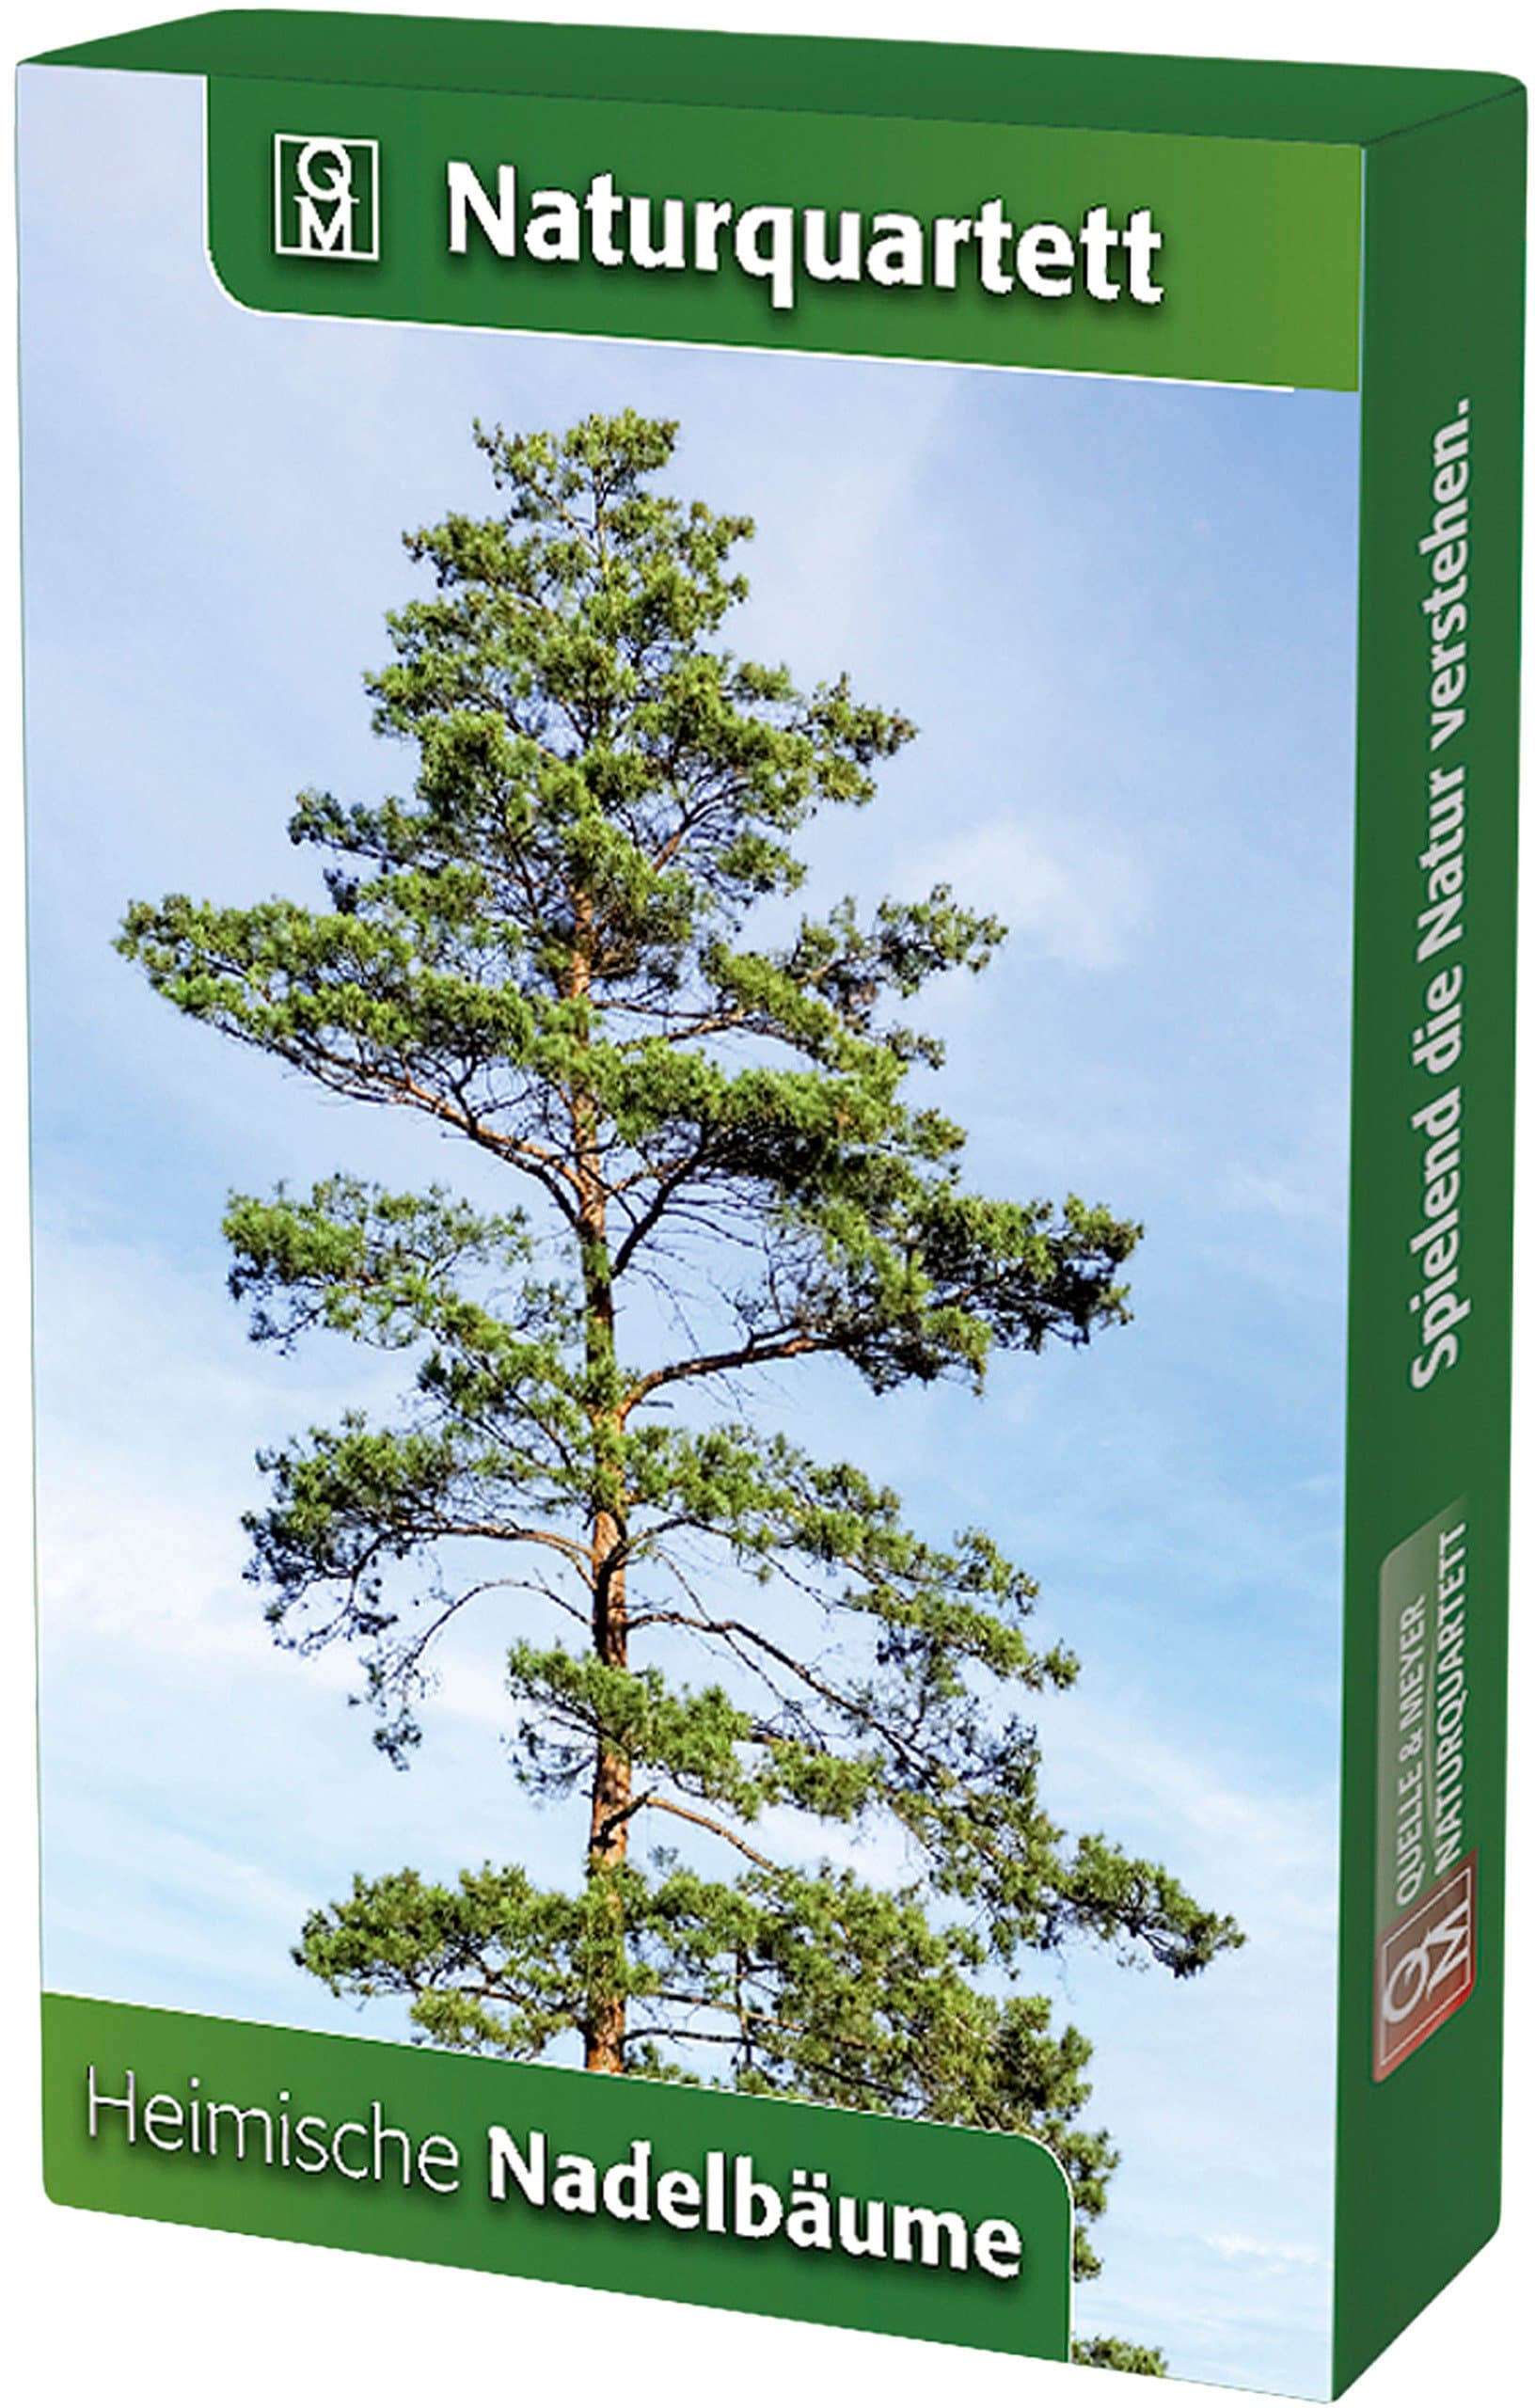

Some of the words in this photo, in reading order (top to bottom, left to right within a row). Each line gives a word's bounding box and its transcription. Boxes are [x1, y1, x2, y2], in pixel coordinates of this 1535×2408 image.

[448, 161, 1164, 309] Naturquartett
[1419, 398, 1470, 751] verstehen.
[1416, 767, 1465, 962] Natur
[1412, 965, 1464, 1074] die
[1410, 1086, 1470, 1388] Spielend
[1399, 1595, 1425, 1731] MEYER
[1399, 1727, 1424, 1762] &
[1434, 1524, 1467, 1875] NATURQUARTETT
[1397, 1762, 1426, 1906] QUELLE
[88, 2065, 460, 2193] Heimische
[488, 2126, 1022, 2278] Nadelbäume
